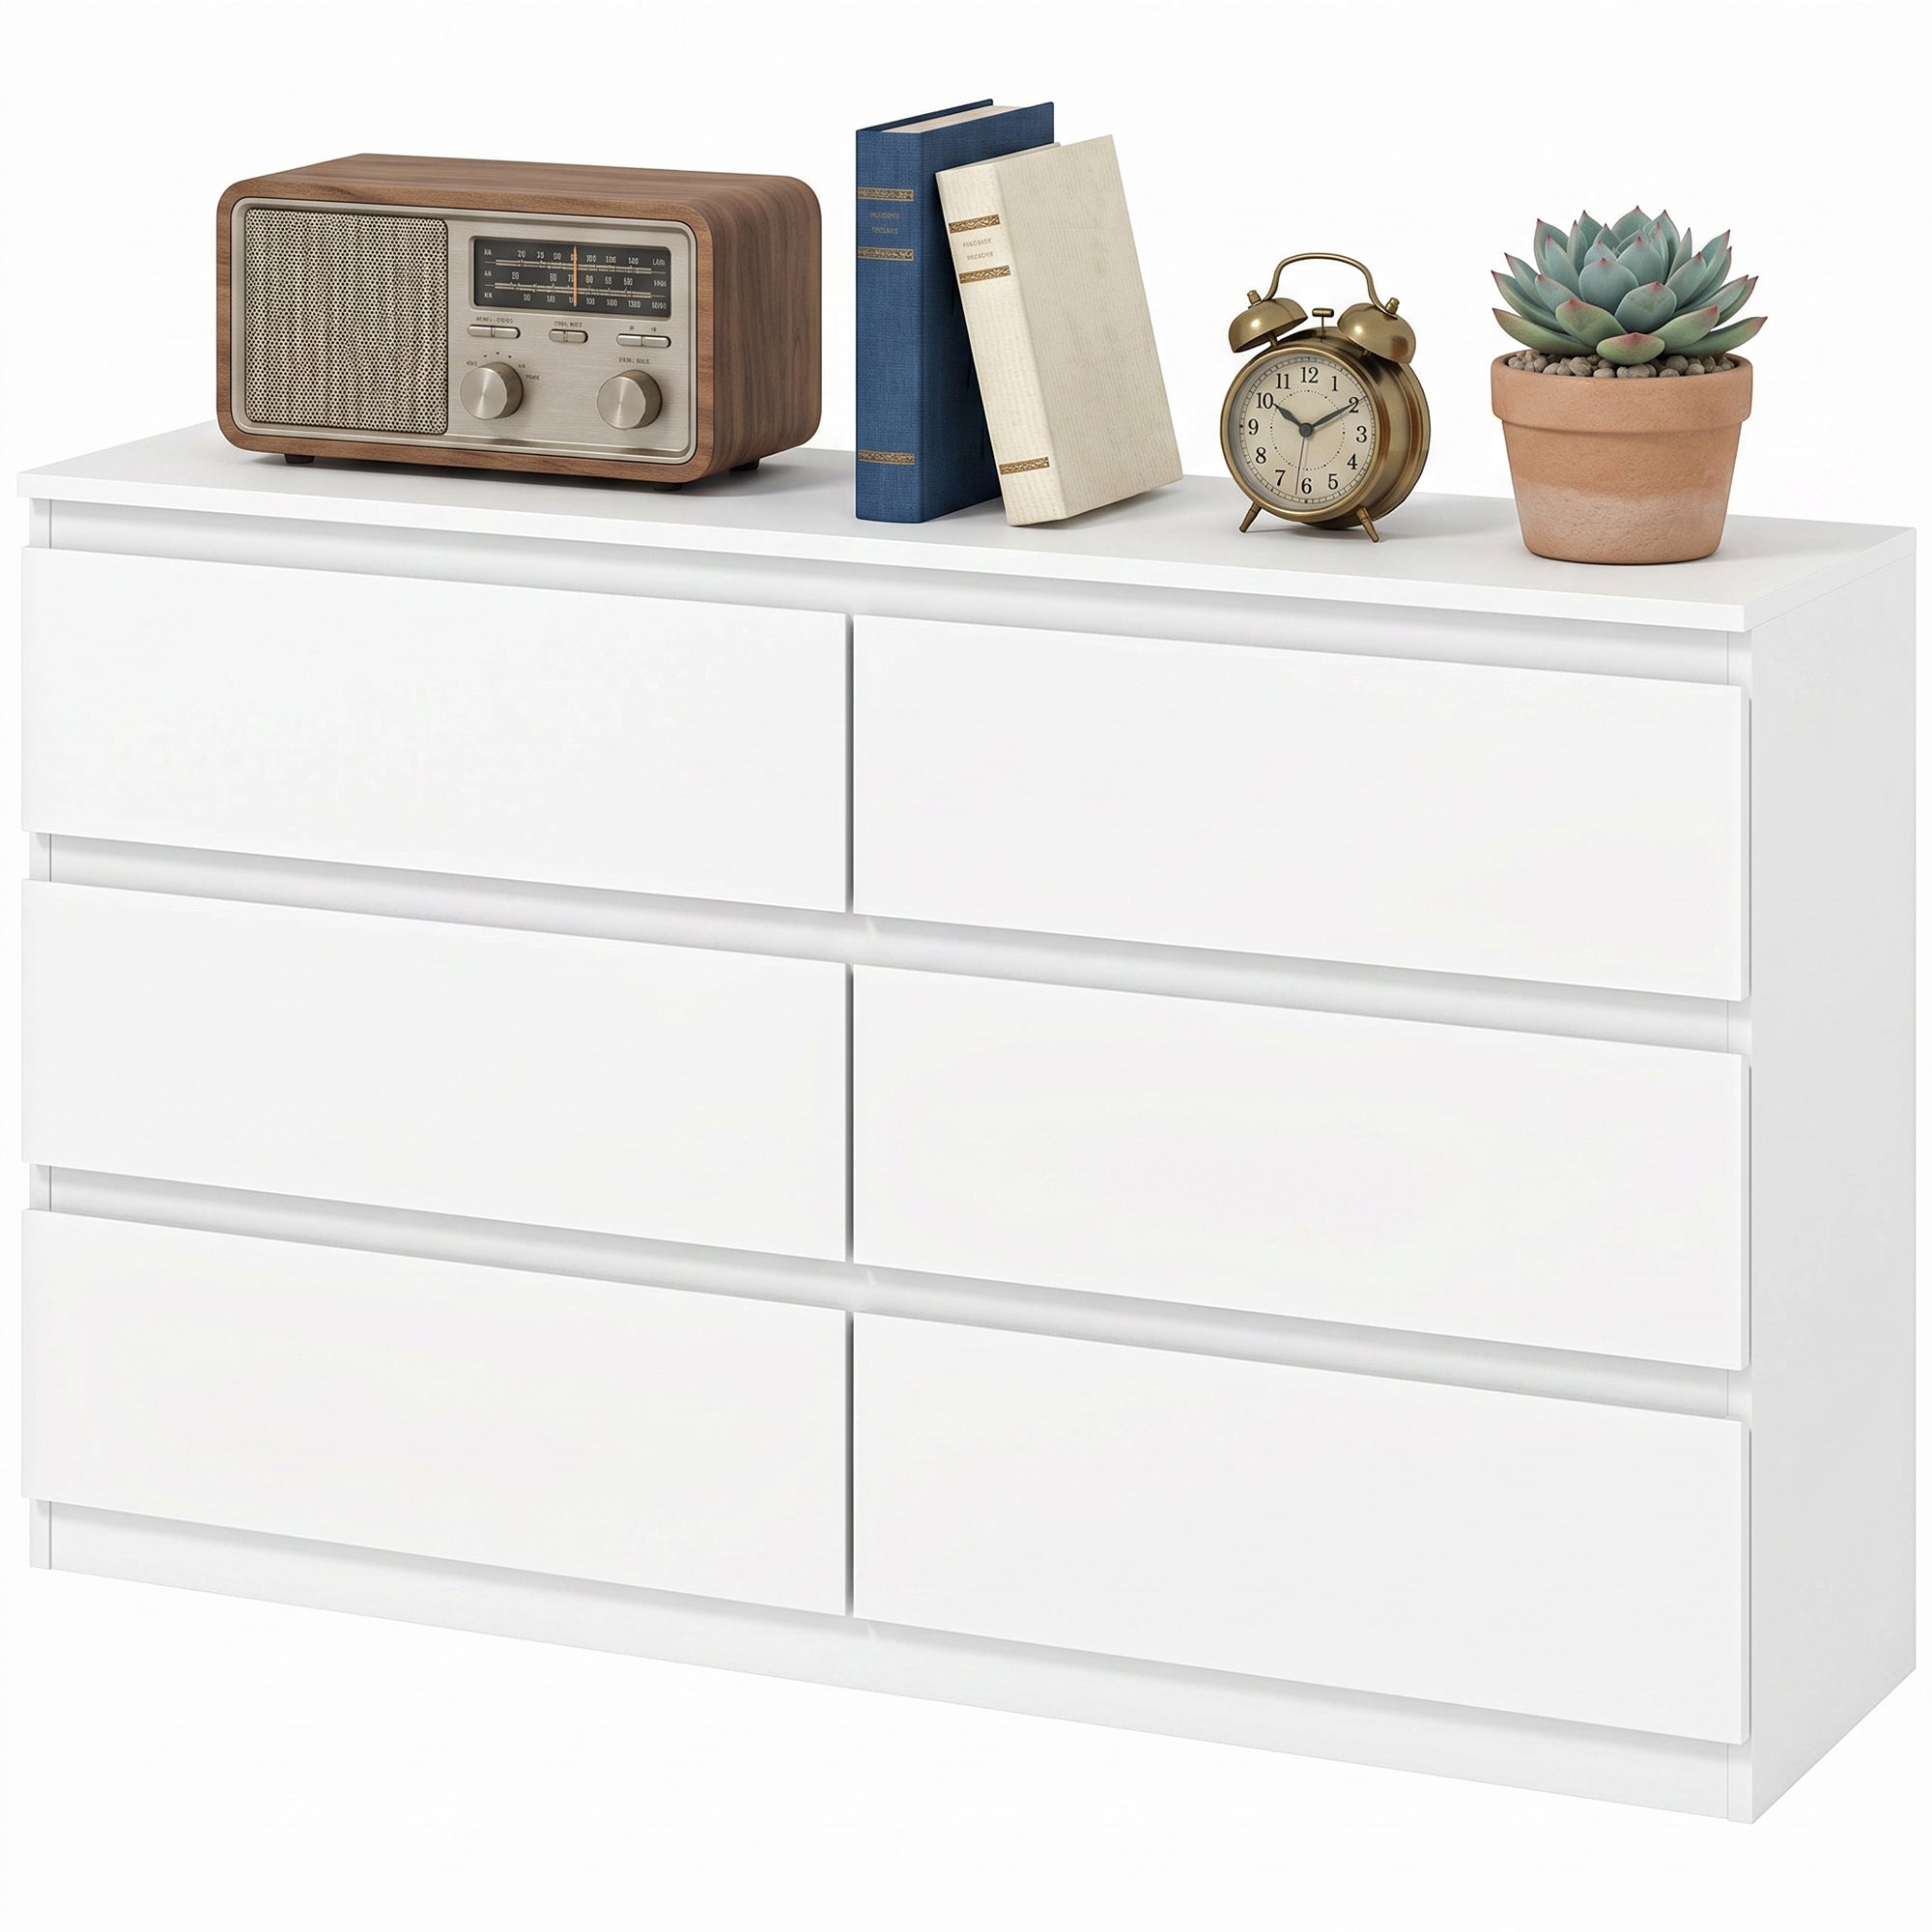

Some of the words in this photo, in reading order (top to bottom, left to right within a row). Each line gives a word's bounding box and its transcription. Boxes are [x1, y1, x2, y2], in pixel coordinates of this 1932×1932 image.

[1276, 373, 1291, 389] 11
[1301, 367, 1319, 384] 12
[1331, 376, 1338, 391] 1
[1257, 392, 1273, 409] 10
[1349, 397, 1359, 412] 2
[1248, 419, 1259, 435] 9
[1356, 426, 1367, 442] 3
[1256, 447, 1266, 464] 8
[1348, 453, 1357, 469] 4
[1275, 469, 1286, 486] 7
[1328, 473, 1338, 490] 5
[1301, 478, 1312, 494] 6
